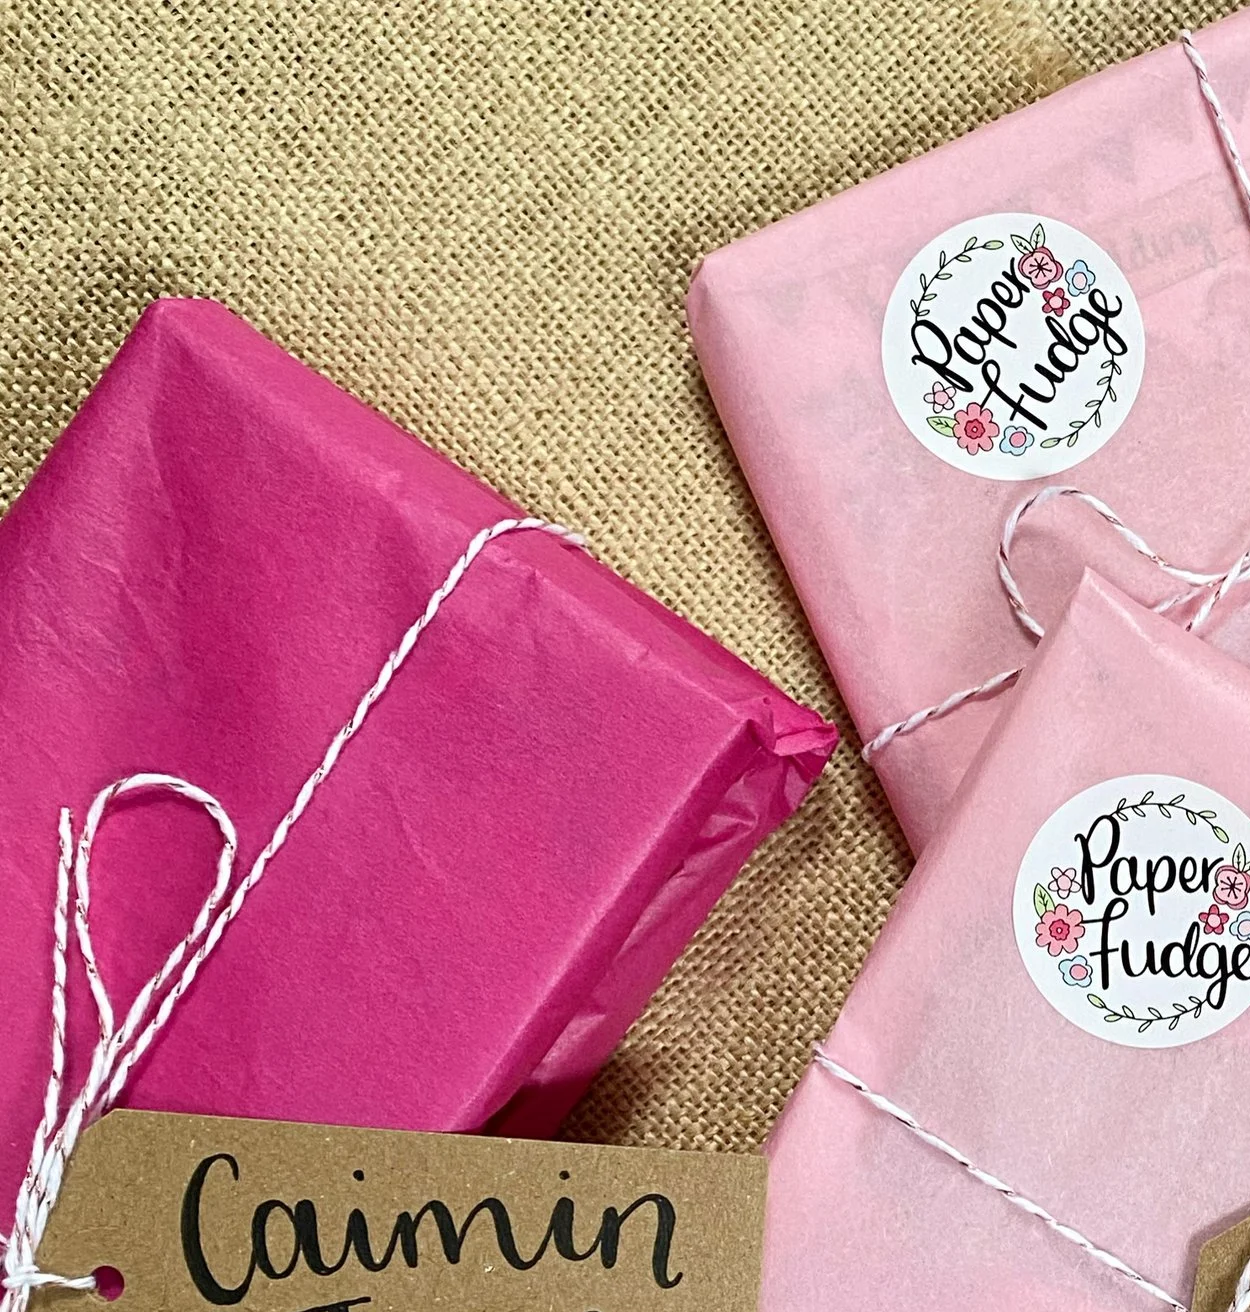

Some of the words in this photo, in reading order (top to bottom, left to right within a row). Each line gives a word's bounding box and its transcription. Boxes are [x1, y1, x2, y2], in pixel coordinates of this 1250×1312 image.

[911, 257, 1030, 393] Paper
[1074, 815, 1224, 916] Paper
[181, 1153, 684, 1305] Caimin
